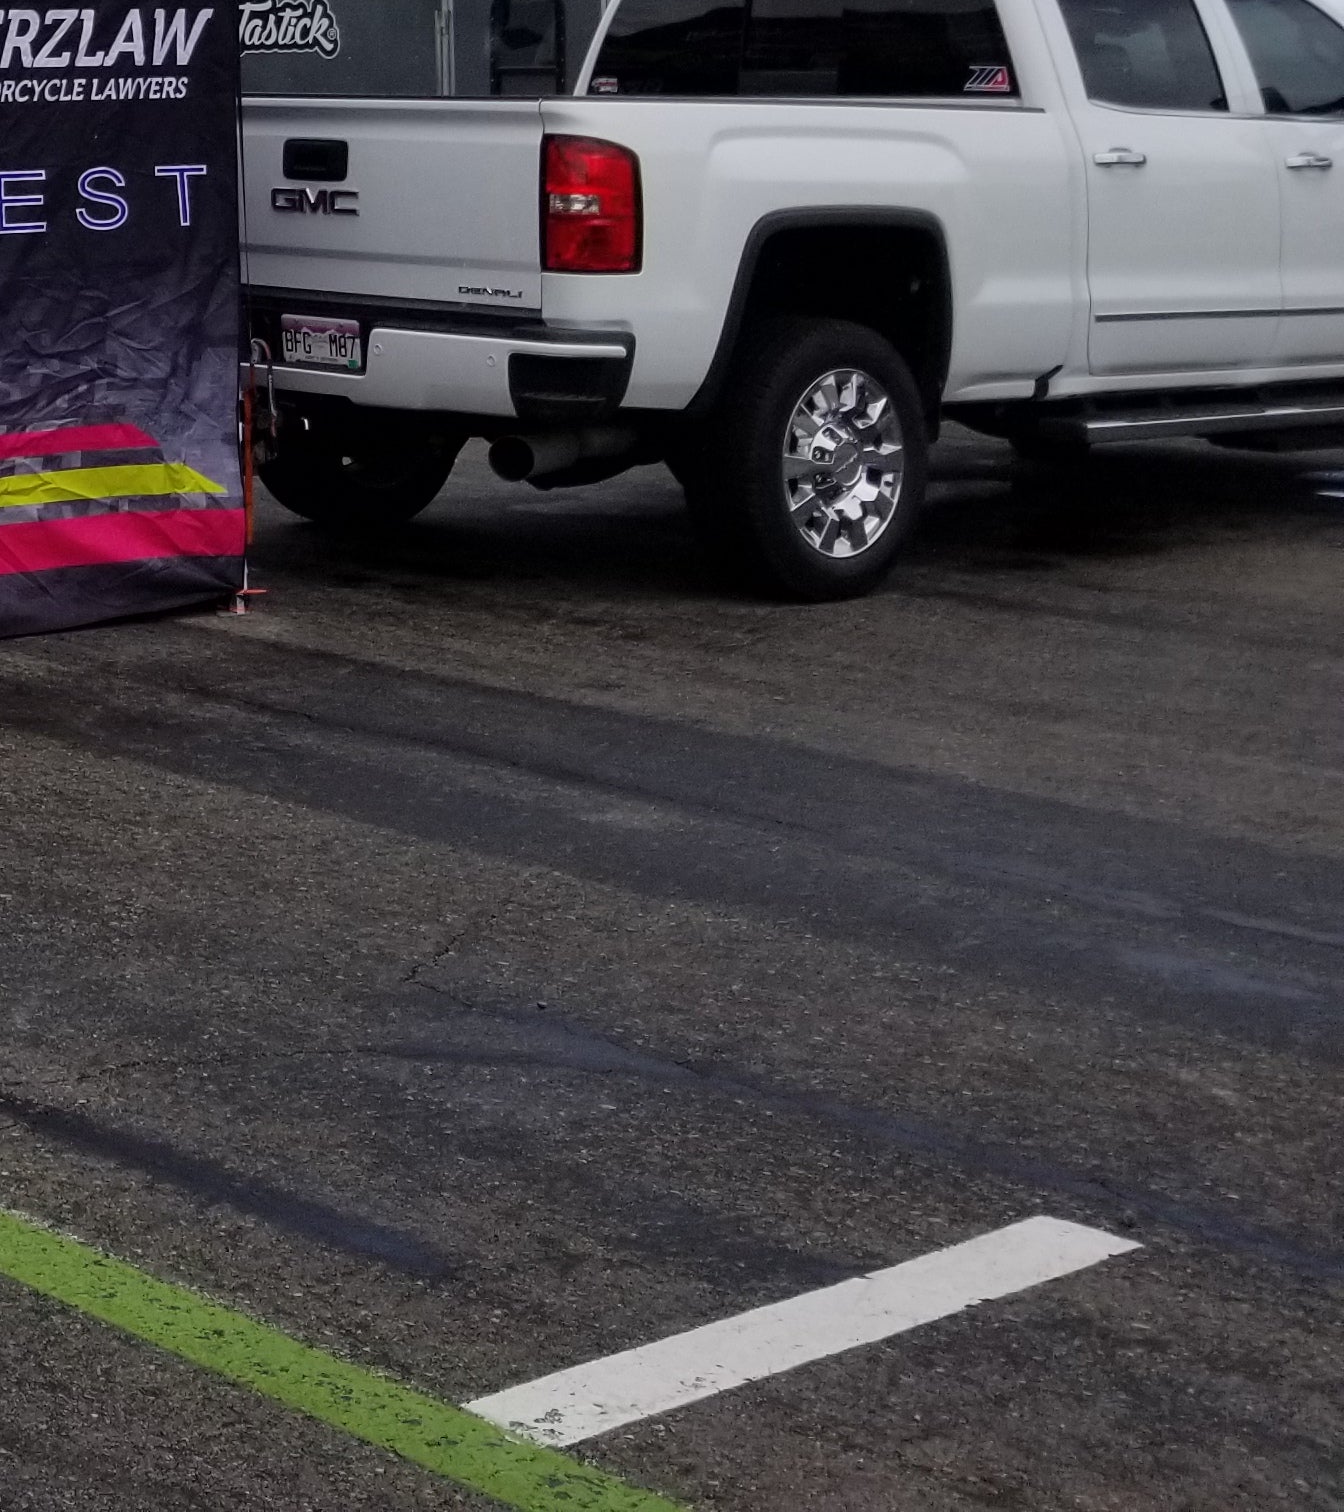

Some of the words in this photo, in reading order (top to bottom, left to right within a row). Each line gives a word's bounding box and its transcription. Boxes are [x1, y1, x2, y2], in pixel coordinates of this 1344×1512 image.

[90, 76, 189, 102] LAWYERS
[271, 188, 360, 216] GMC
[458, 286, 523, 299] DENALI
[285, 330, 312, 354] BFG
